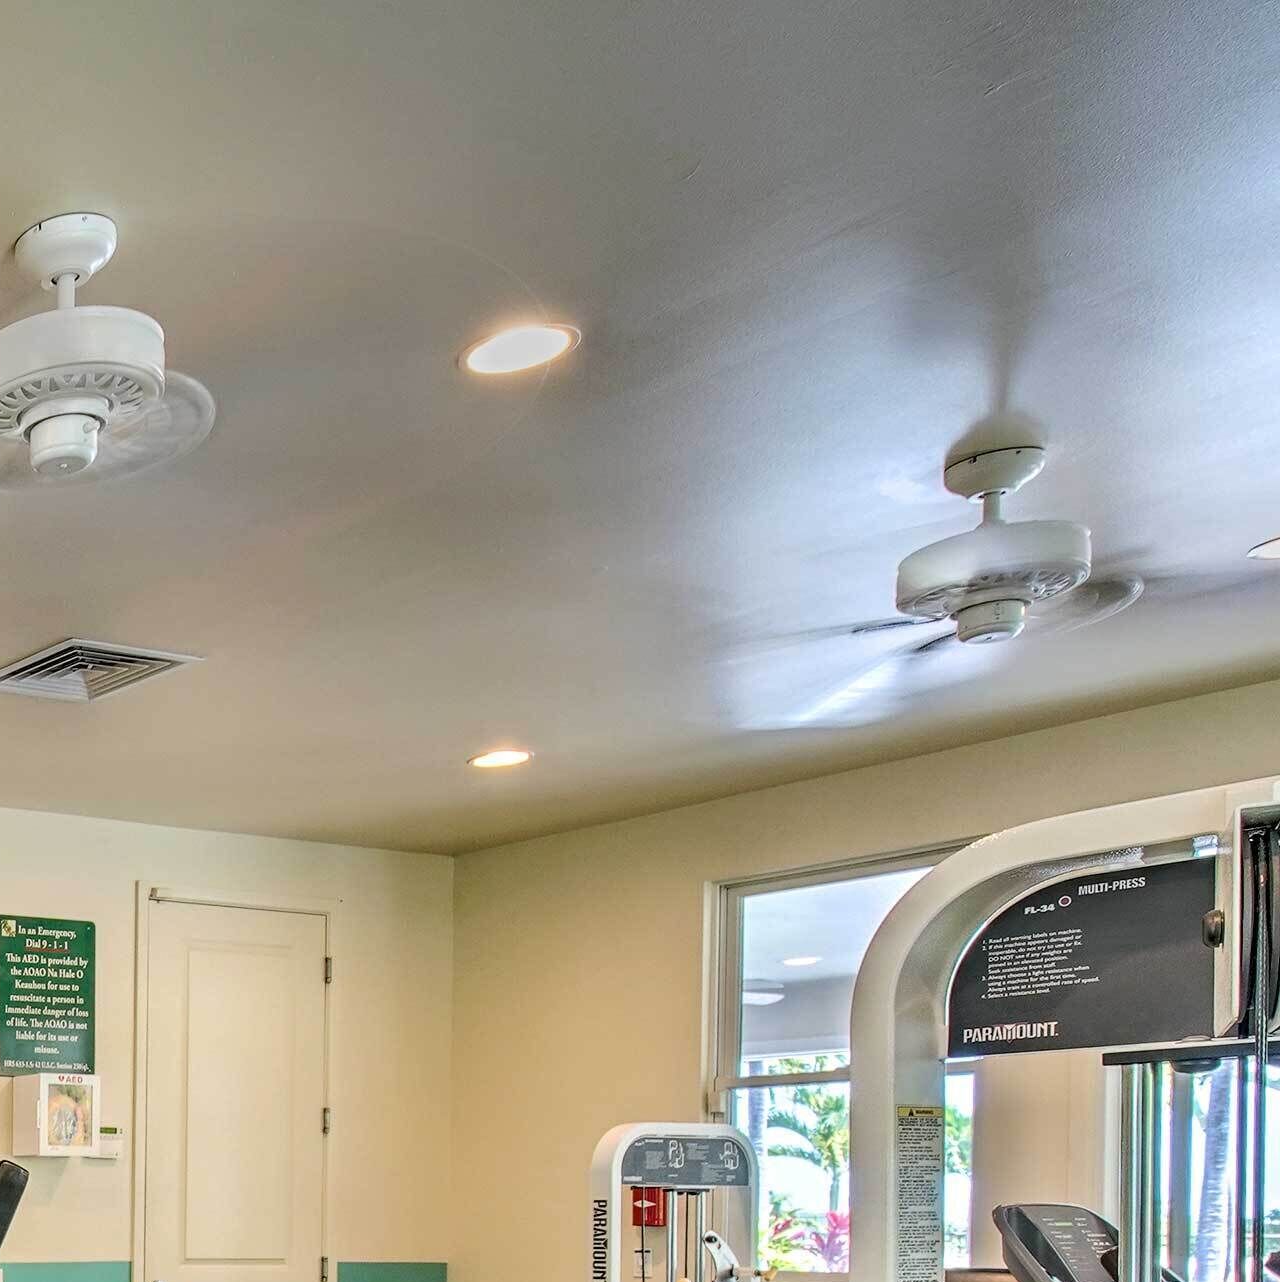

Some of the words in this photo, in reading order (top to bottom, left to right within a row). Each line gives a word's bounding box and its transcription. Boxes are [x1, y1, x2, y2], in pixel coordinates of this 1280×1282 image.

[1078, 877, 1146, 896] MULTI-PRESS
[1024, 903, 1055, 915] FL-34
[18, 925, 26, 934] In
[38, 927, 76, 939] Emergency,
[26, 939, 41, 947] Dial
[42, 940, 47, 948] 9
[54, 941, 57, 949] 1
[6, 953, 20, 962] This
[22, 955, 39, 963] AED
[41, 956, 46, 964] is
[48, 956, 78, 967] provided
[80, 957, 88, 968] by
[11, 966, 21, 975] the
[23, 968, 46, 976] AOAO
[48, 969, 57, 977] Na
[60, 969, 75, 978] Hale
[77, 970, 83, 978] O
[15, 980, 46, 989] Keauhou
[47, 981, 57, 990] for
[72, 982, 79, 991] to
[10, 994, 45, 1002] resuscitate
[52, 997, 75, 1005] person
[43, 1006, 66, 1018] danger
[67, 1007, 76, 1016] of
[76, 1008, 88, 1017] loss
[6, 1017, 15, 1026] of
[15, 1017, 28, 1027] life.
[30, 1019, 42, 1027] The
[44, 1020, 66, 1029] AOAO
[68, 1021, 74, 1029] is
[16, 1031, 34, 1039] liable
[36, 1031, 46, 1040] for
[48, 1033, 56, 1041] its
[963, 1021, 1056, 1043] PARAMOUNT
[35, 1045, 59, 1054] misuse.
